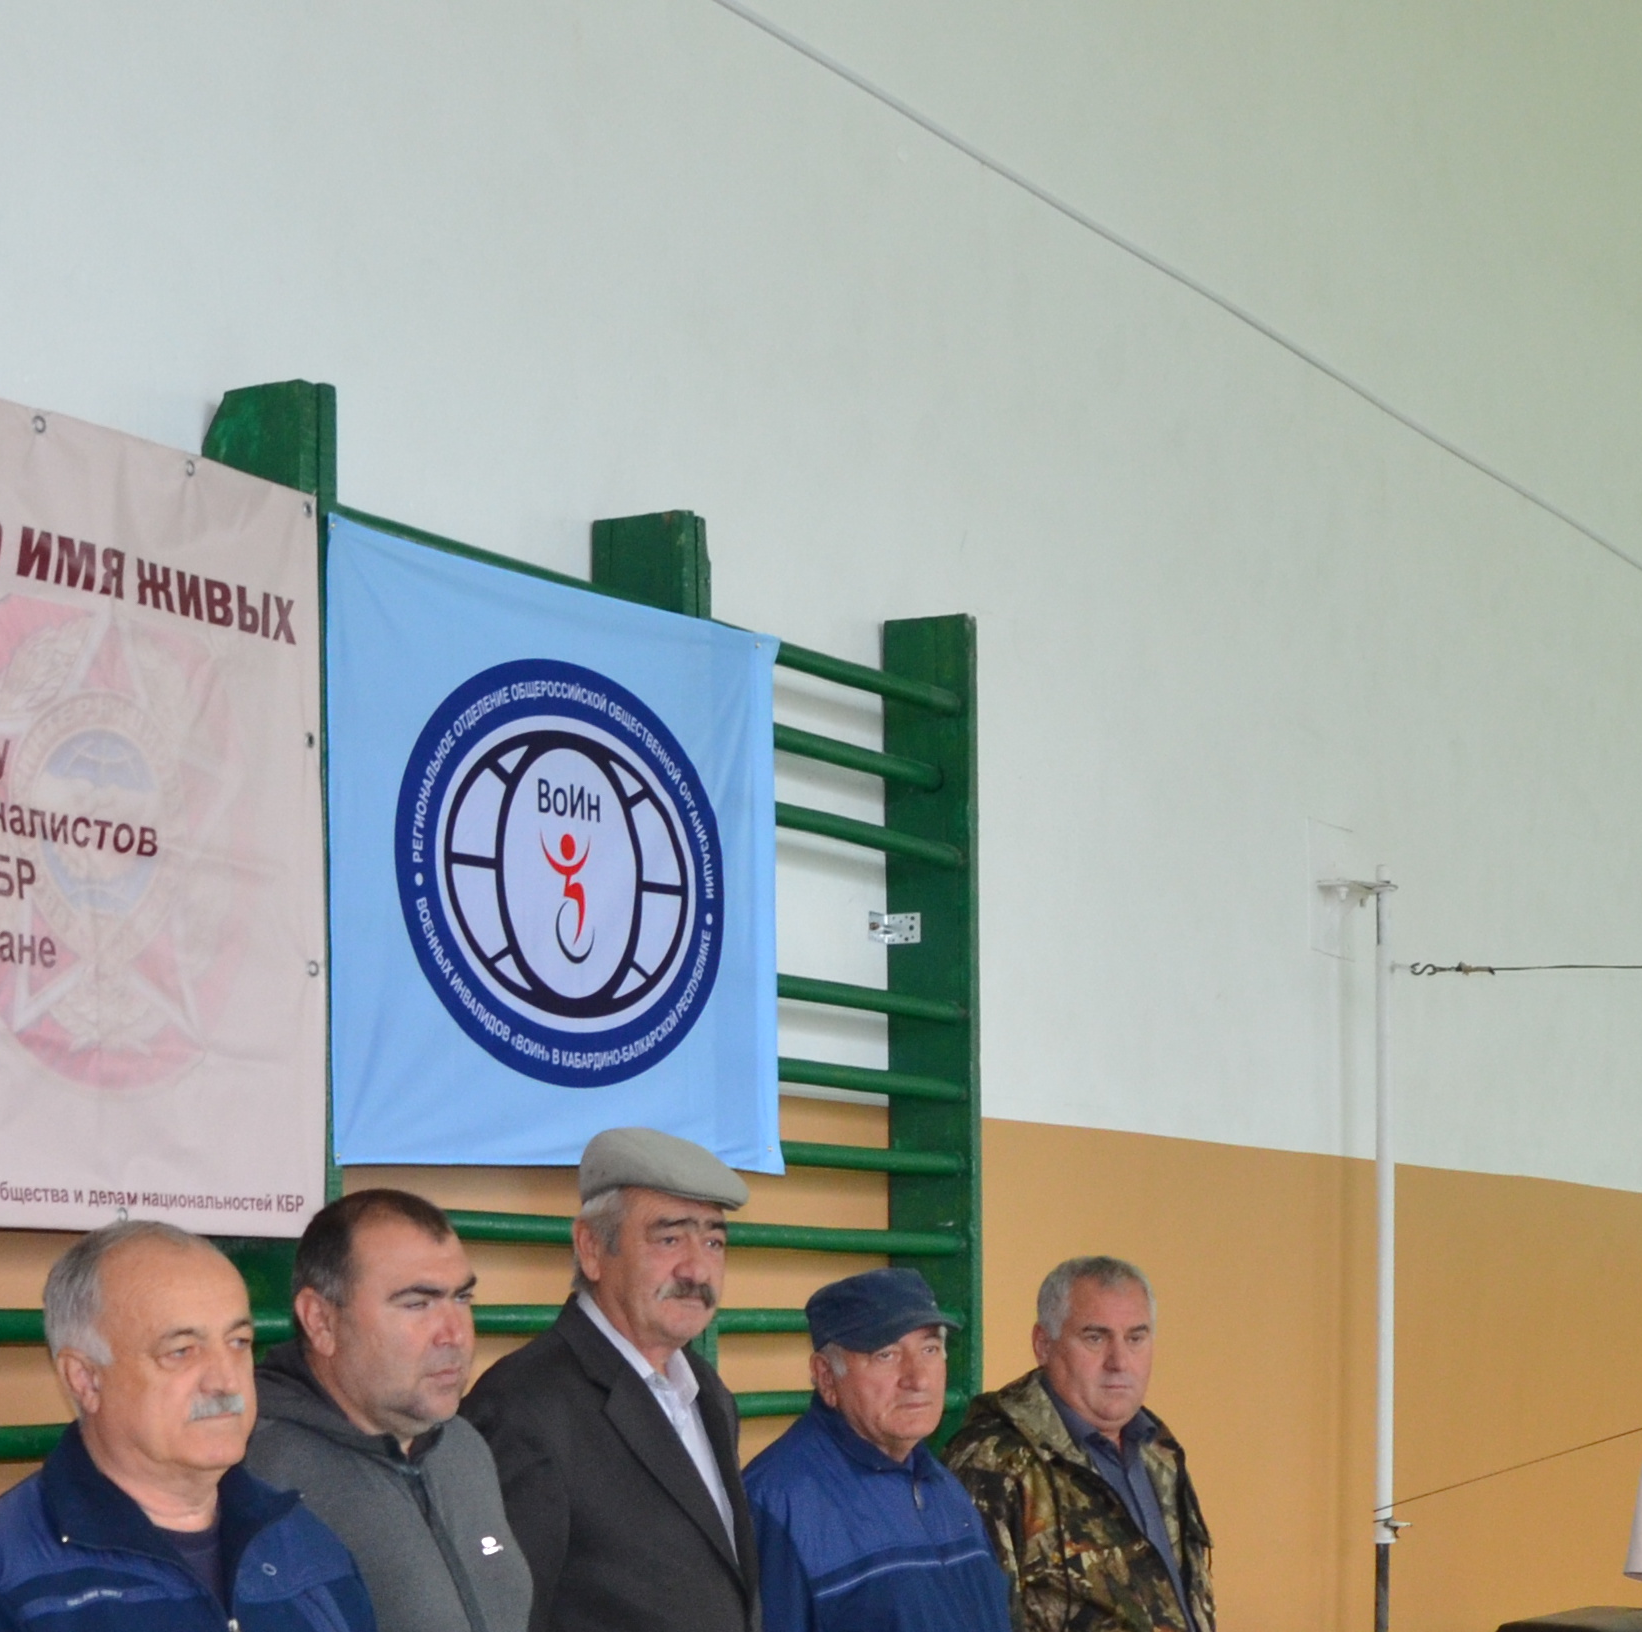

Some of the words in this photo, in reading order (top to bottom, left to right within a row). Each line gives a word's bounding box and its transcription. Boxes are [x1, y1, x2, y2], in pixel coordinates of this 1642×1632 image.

[16, 525, 126, 600] ИМЯ
[136, 557, 297, 646] ЖИВЫХ
[412, 729, 457, 863] РЕГИОНАЛЬНОЕ
[453, 686, 511, 737] ОТДЕЛЕНИЕ
[510, 680, 608, 714] ОБЩЕРОССИЙСКОЙ
[608, 701, 682, 786] ОБЩЕСТВЕННОЙ
[678, 783, 715, 900] ОРГАНИЗАЦИИ
[538, 777, 601, 823] ВоИн
[416, 896, 455, 980] ВОЕННЫХ
[449, 972, 512, 1043] ИНВАЛИДОВ
[511, 1034, 550, 1062] «ВОИН»
[552, 1048, 561, 1065] В
[561, 1008, 679, 1072] КАБАРДИНО-БАЛКАРСКОЙ
[675, 929, 712, 1020] РЕСПУБЛИКЕ
[74, 1188, 84, 1203] и
[88, 1189, 138, 1207] делам
[142, 1191, 273, 1212] национальностей
[276, 1194, 305, 1213] КБР
